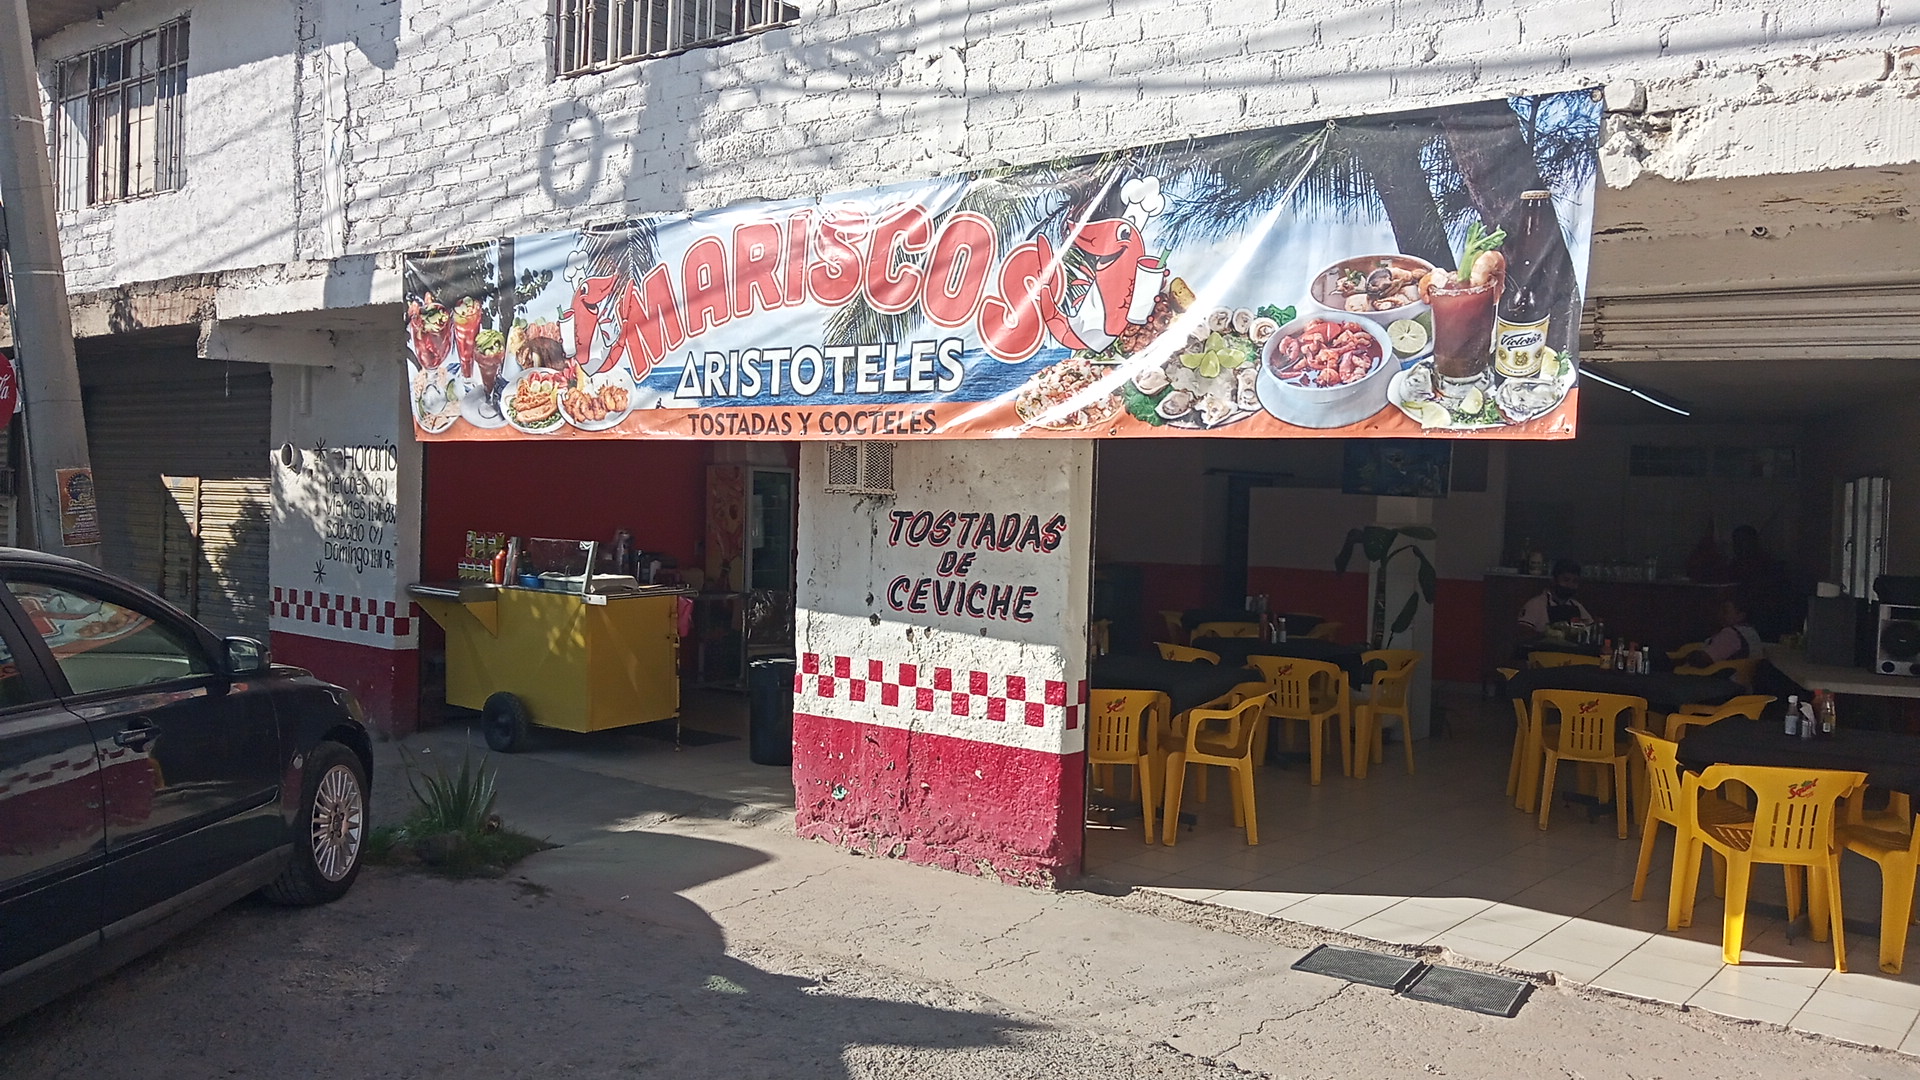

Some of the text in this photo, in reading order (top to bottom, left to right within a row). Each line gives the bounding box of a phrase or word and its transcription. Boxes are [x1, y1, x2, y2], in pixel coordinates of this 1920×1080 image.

[621, 200, 1066, 382] MARISCOS
[674, 336, 965, 399] ARISTOTELES
[687, 409, 937, 437] TOSTADAS Y COCTELES
[342, 439, 398, 472] Horario
[888, 509, 1068, 554] TOSTADAS
[324, 541, 370, 574] Domingo
[936, 550, 977, 577] DE
[887, 574, 1040, 623] CEVICHE
